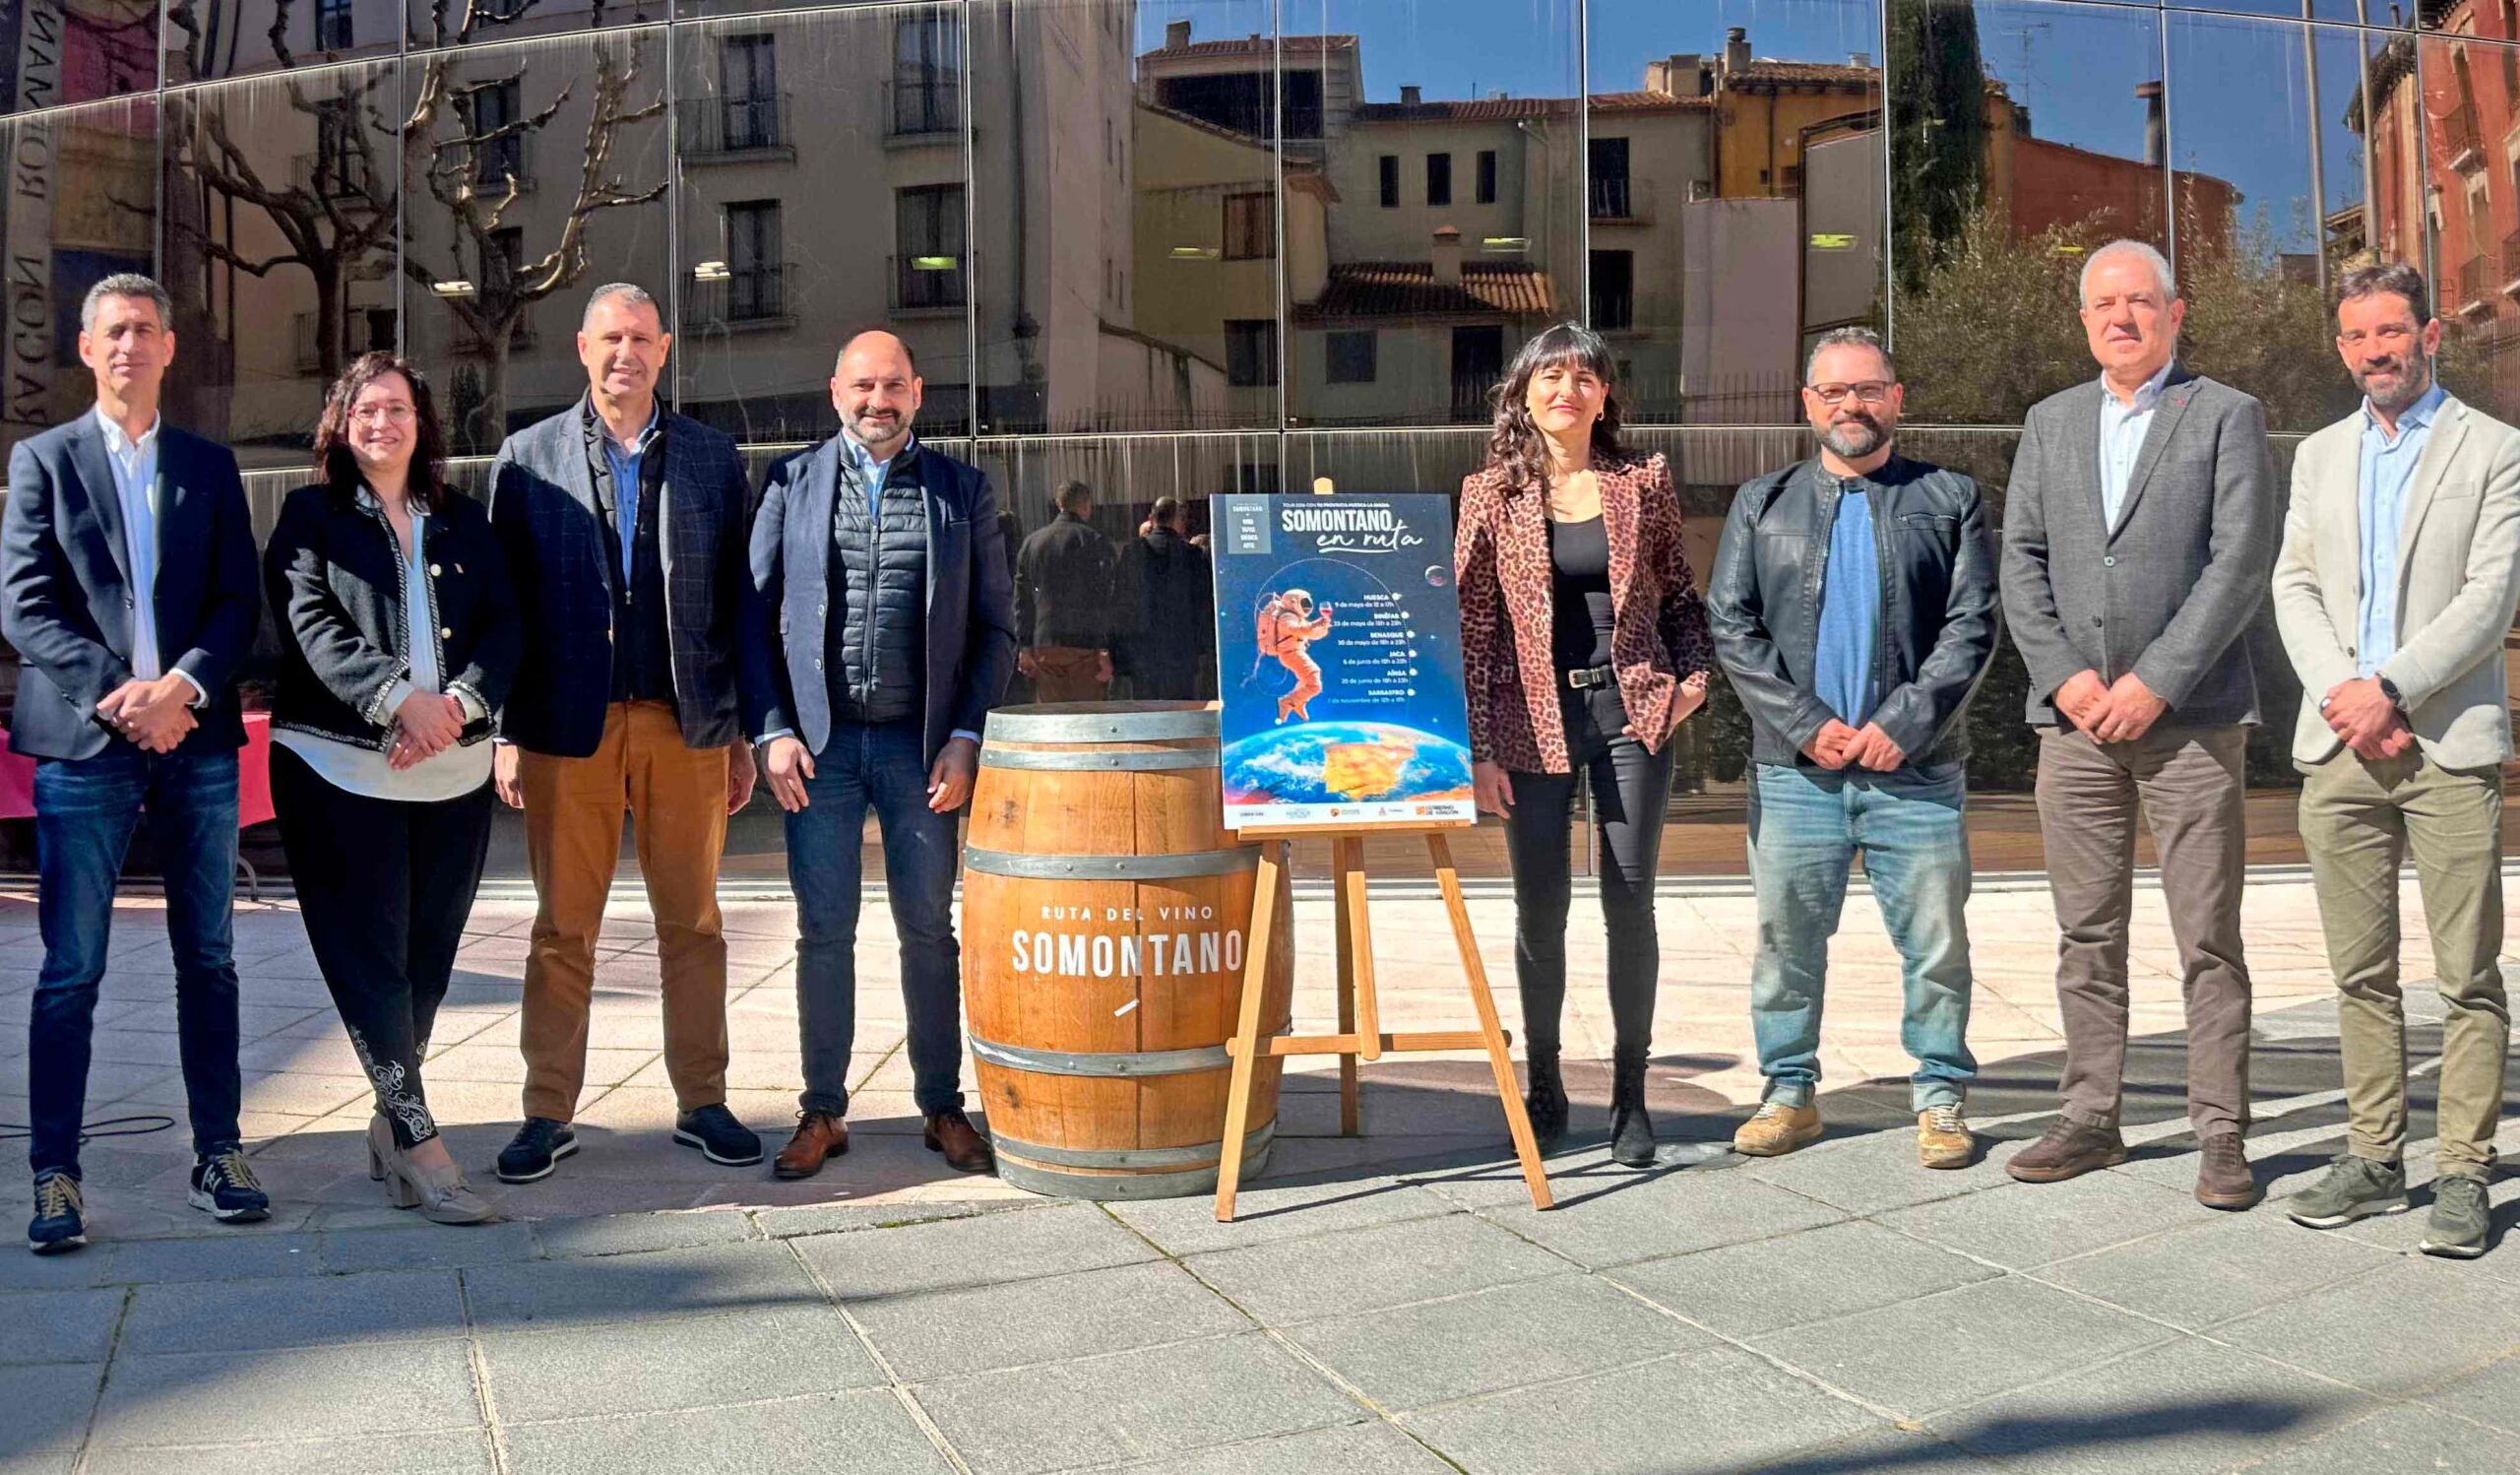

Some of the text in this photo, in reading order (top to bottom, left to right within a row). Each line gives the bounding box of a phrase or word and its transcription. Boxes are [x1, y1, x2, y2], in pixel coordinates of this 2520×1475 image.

[1282, 509, 1392, 532] SOMONTANO
[1316, 519, 1423, 550] en ruta
[1041, 906, 1213, 922] RUTA DEL VINO
[1012, 930, 1242, 978] SOMONTANO
